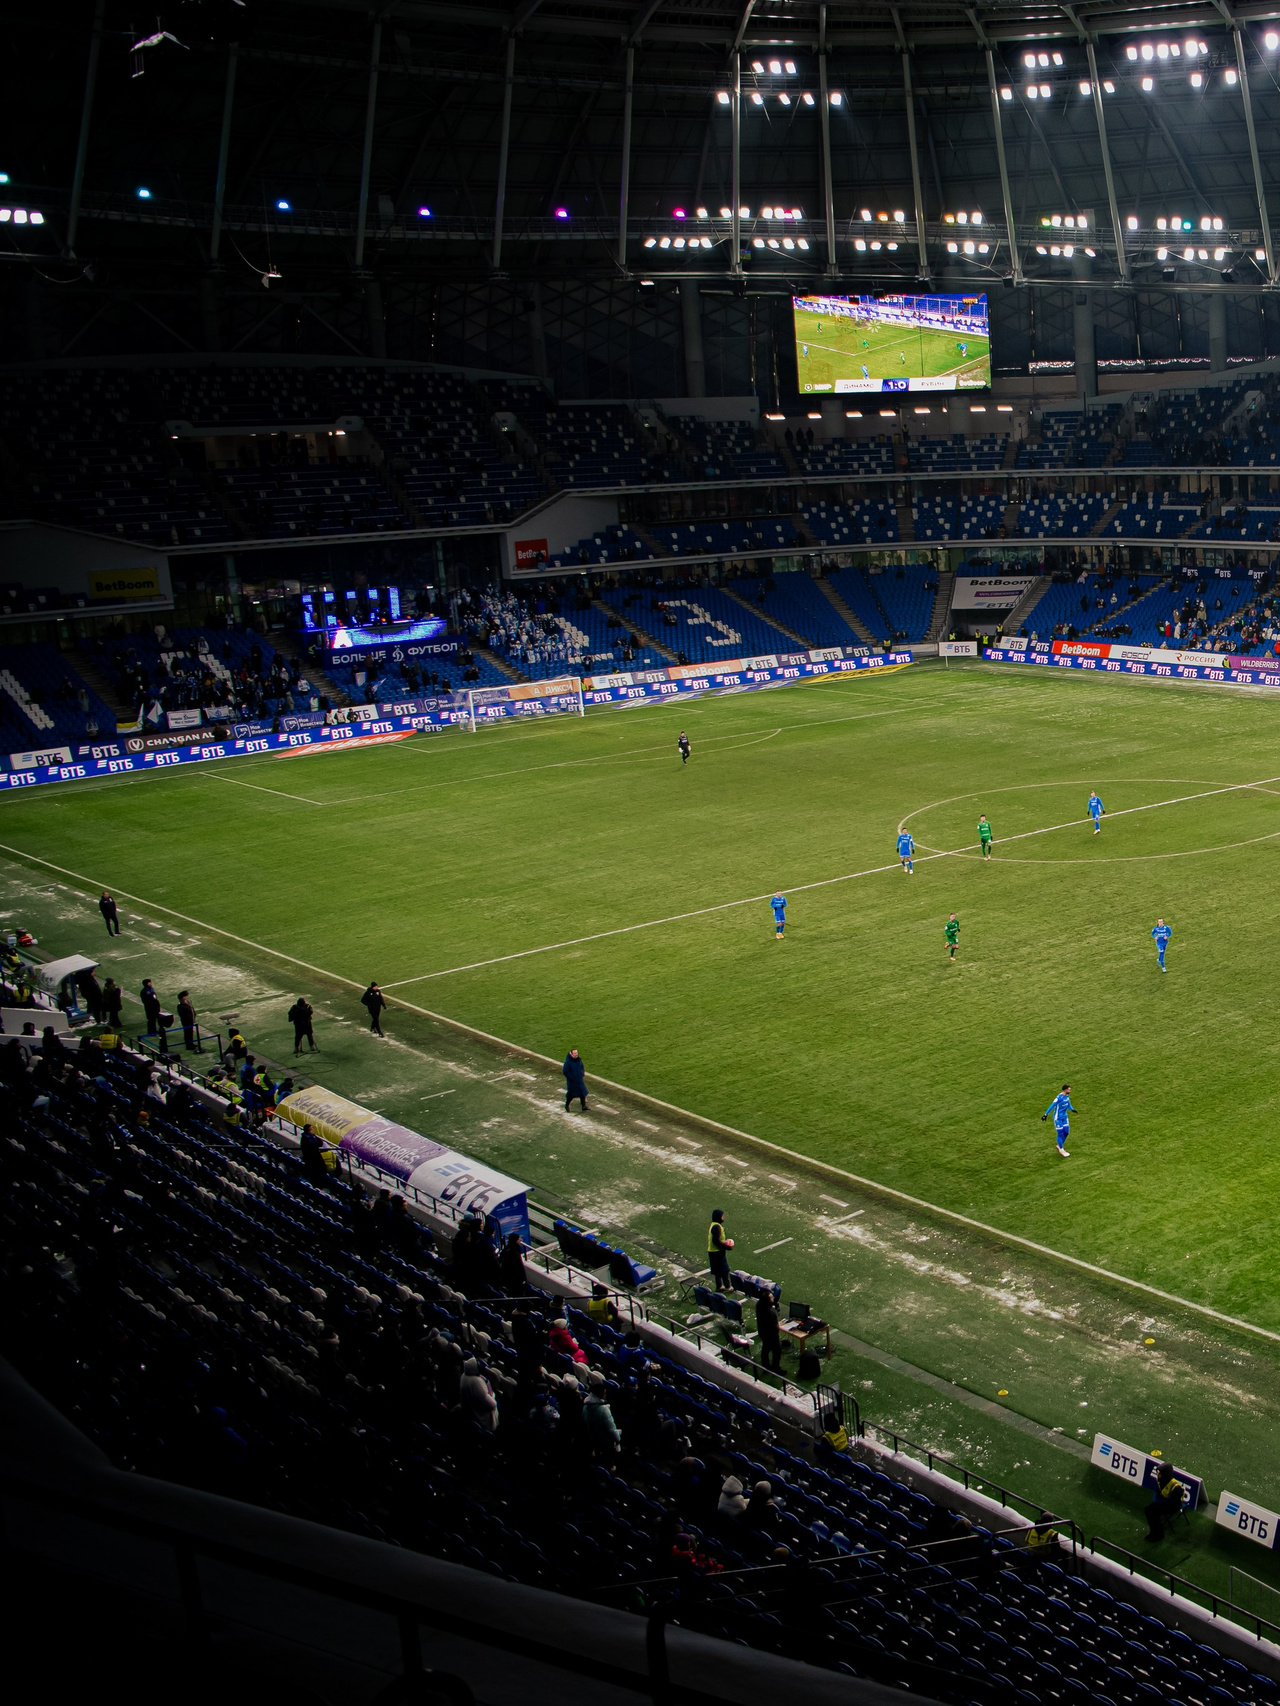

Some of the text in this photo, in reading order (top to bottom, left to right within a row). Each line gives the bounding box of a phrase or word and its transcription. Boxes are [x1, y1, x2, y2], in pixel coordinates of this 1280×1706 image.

[887, 381, 906, 390] 1:0
[96, 580, 154, 592] BetBoom
[407, 642, 458, 656] ФУТБОЛ
[954, 645, 970, 653] ВТБ
[1010, 640, 1023, 650] ВТБ
[1035, 642, 1049, 652] ВТБ
[1062, 644, 1100, 656] BetBoom
[823, 650, 839, 660] ВТБ
[853, 646, 870, 656] ВТБ
[1121, 652, 1149, 661] BOSCO
[755, 658, 773, 669] ВТБ
[789, 655, 807, 665] ВТБ
[1184, 655, 1216, 664] РОССИЯ
[1240, 660, 1279, 669] WILDBERRIES
[681, 665, 731, 678] BetBoom
[990, 650, 1003, 660] ВТБ
[1012, 652, 1025, 662] ВТБ
[1035, 654, 1048, 664] ВТБ
[1058, 656, 1072, 666] ВТБ
[1082, 658, 1096, 669] ВТБ
[1107, 661, 1120, 671] ВТБ
[1132, 662, 1145, 673] ВТБ
[1157, 665, 1171, 675] ВТБ
[1183, 667, 1197, 678] ВТБ
[1210, 669, 1224, 680] ВТБ
[1237, 672, 1252, 682] ВТБ
[1265, 674, 1280, 685] ВТБ
[609, 676, 627, 687] ВТБ
[647, 672, 666, 682] ВТБ
[545, 684, 573, 694] ДИКСИ
[394, 704, 417, 715] ВТБ
[10, 773, 36, 786] ВТБ
[60, 766, 86, 779] ВТБ
[109, 759, 134, 771] ВТБ
[155, 752, 180, 765] ВТБ
[202, 746, 225, 758] ВТБ
[246, 739, 269, 751] ВТБ
[290, 733, 311, 745] ВТБ
[331, 727, 353, 739] ВТБ
[372, 721, 393, 733] ВТБ
[594, 691, 612, 702] ВТБ
[628, 686, 645, 697] ВТБ
[661, 682, 678, 693] ВТБ
[693, 678, 710, 689] ВТБ
[724, 675, 741, 685] ВТБ
[754, 671, 771, 682] ВТБ
[784, 667, 800, 677] ВТБ
[813, 662, 828, 673] ВТБ
[841, 659, 856, 670] ВТБ
[869, 656, 884, 666] ВТБ
[896, 652, 911, 663] ВТБ
[425, 723, 443, 732] ВТБ
[147, 733, 201, 746] CHANGAN
[92, 745, 119, 759] ВТБ
[291, 1094, 352, 1130] BetBoom
[355, 1127, 418, 1166] WILDBERRIES
[442, 1174, 504, 1213] ВТБ
[1111, 1452, 1138, 1477] ВТБ
[1238, 1512, 1268, 1539] ВТБ
